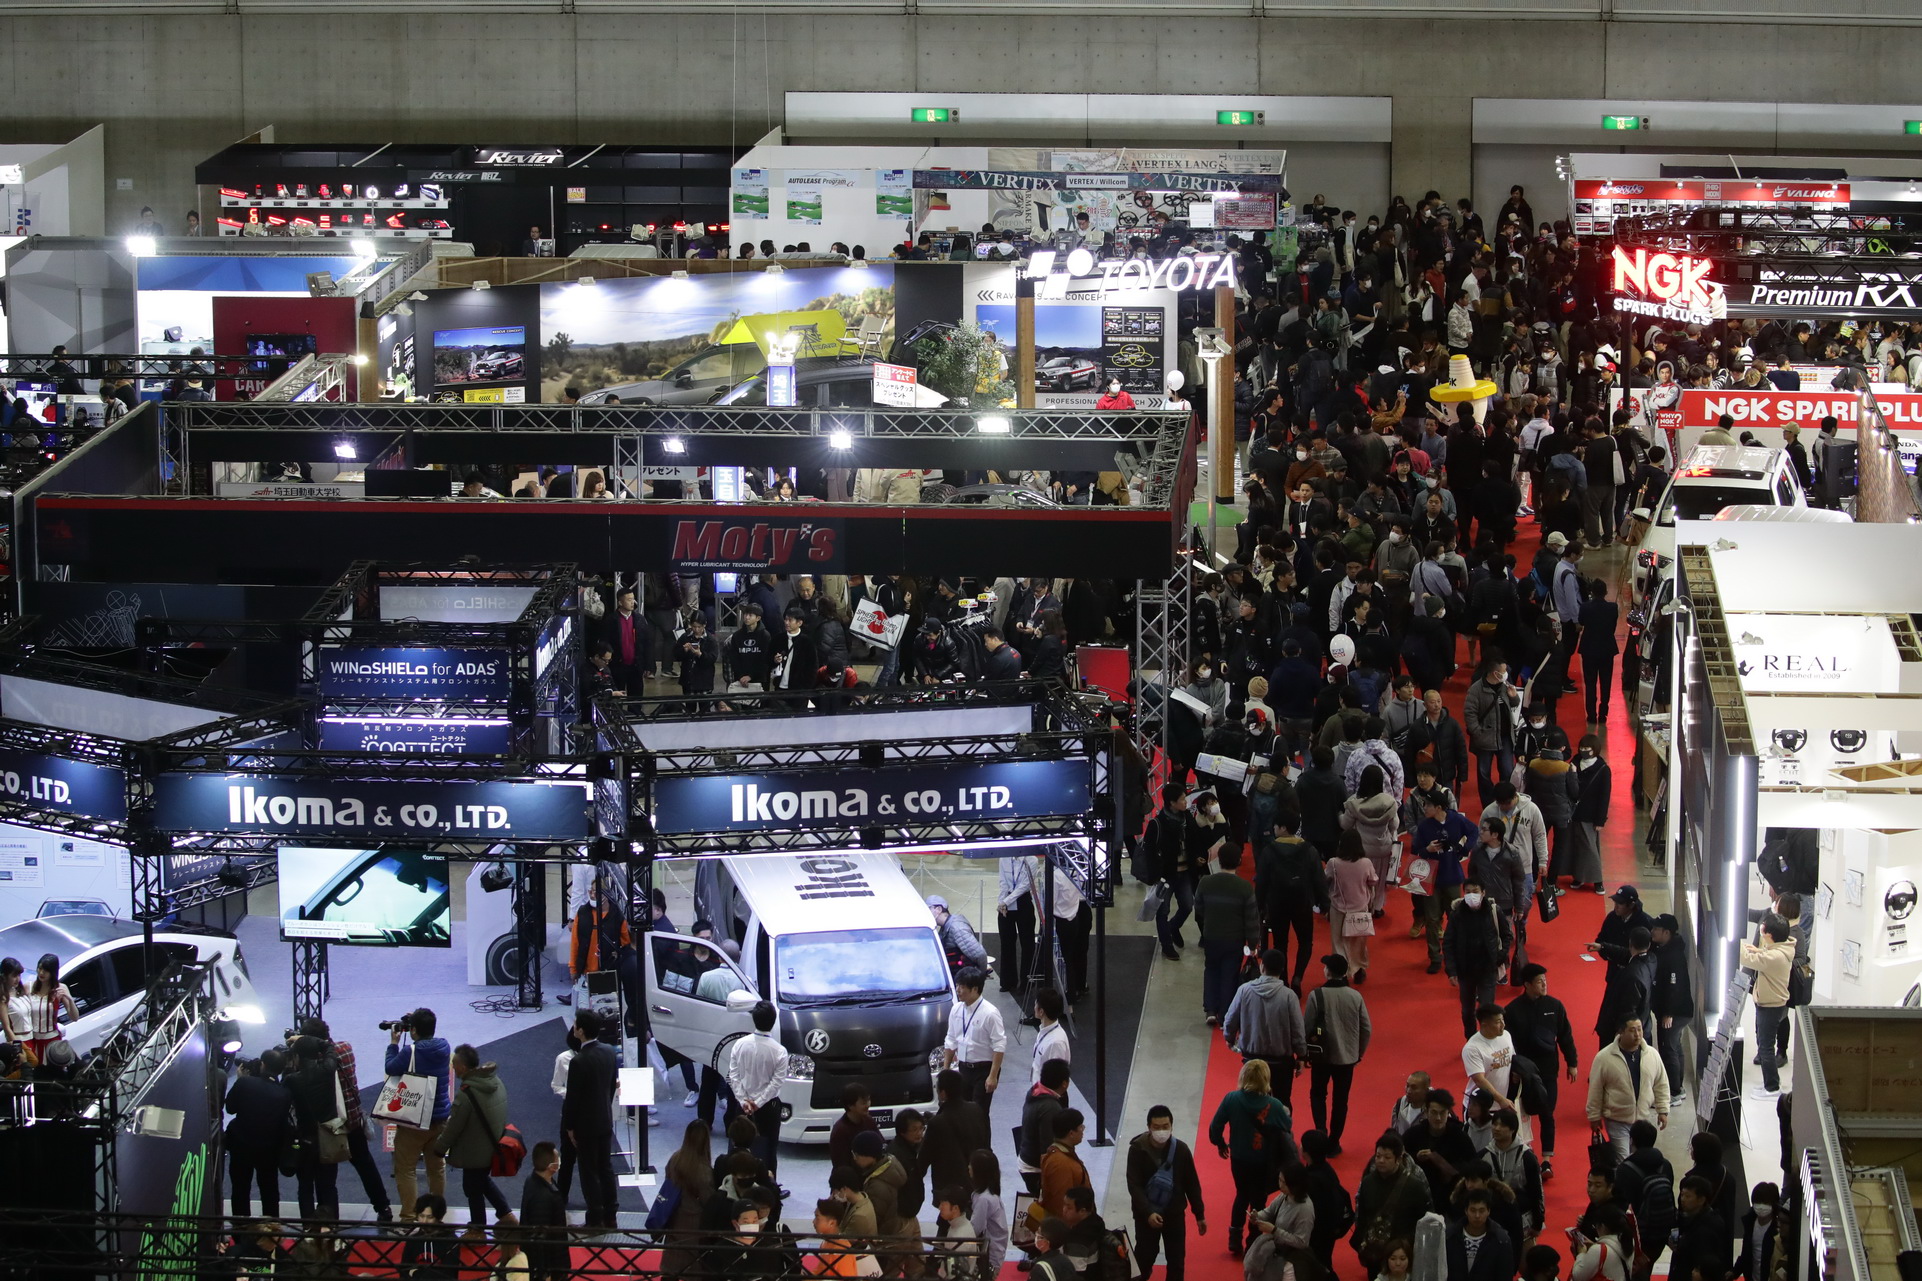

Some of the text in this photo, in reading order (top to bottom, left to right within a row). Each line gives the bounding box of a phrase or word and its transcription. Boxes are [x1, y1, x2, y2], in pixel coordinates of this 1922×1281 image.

[474, 152, 564, 164] Revier
[978, 171, 1059, 191] VERTEX
[1163, 173, 1243, 193] VERTEX
[1098, 254, 1236, 295] TOYOTA
[1614, 244, 1714, 307] NGK
[1750, 285, 1853, 306] Premium
[1613, 298, 1714, 326] SPARK PLUGS
[1045, 397, 1098, 405] PROFESSIONA
[1704, 397, 1771, 422] NGK
[274, 487, 341, 497] 埼玉自動車大学校
[672, 521, 836, 567] Moty's
[432, 661, 451, 675] for
[455, 662, 496, 675] ADAS
[1764, 655, 1848, 671] REAL
[32, 775, 72, 805] LTD.
[229, 785, 511, 831] Ikoma & CO., LTD.
[732, 783, 1014, 822] Ikoma & CO., LTD.
[400, 1087, 424, 1100] Liberty
[401, 1097, 419, 1108] Walk
